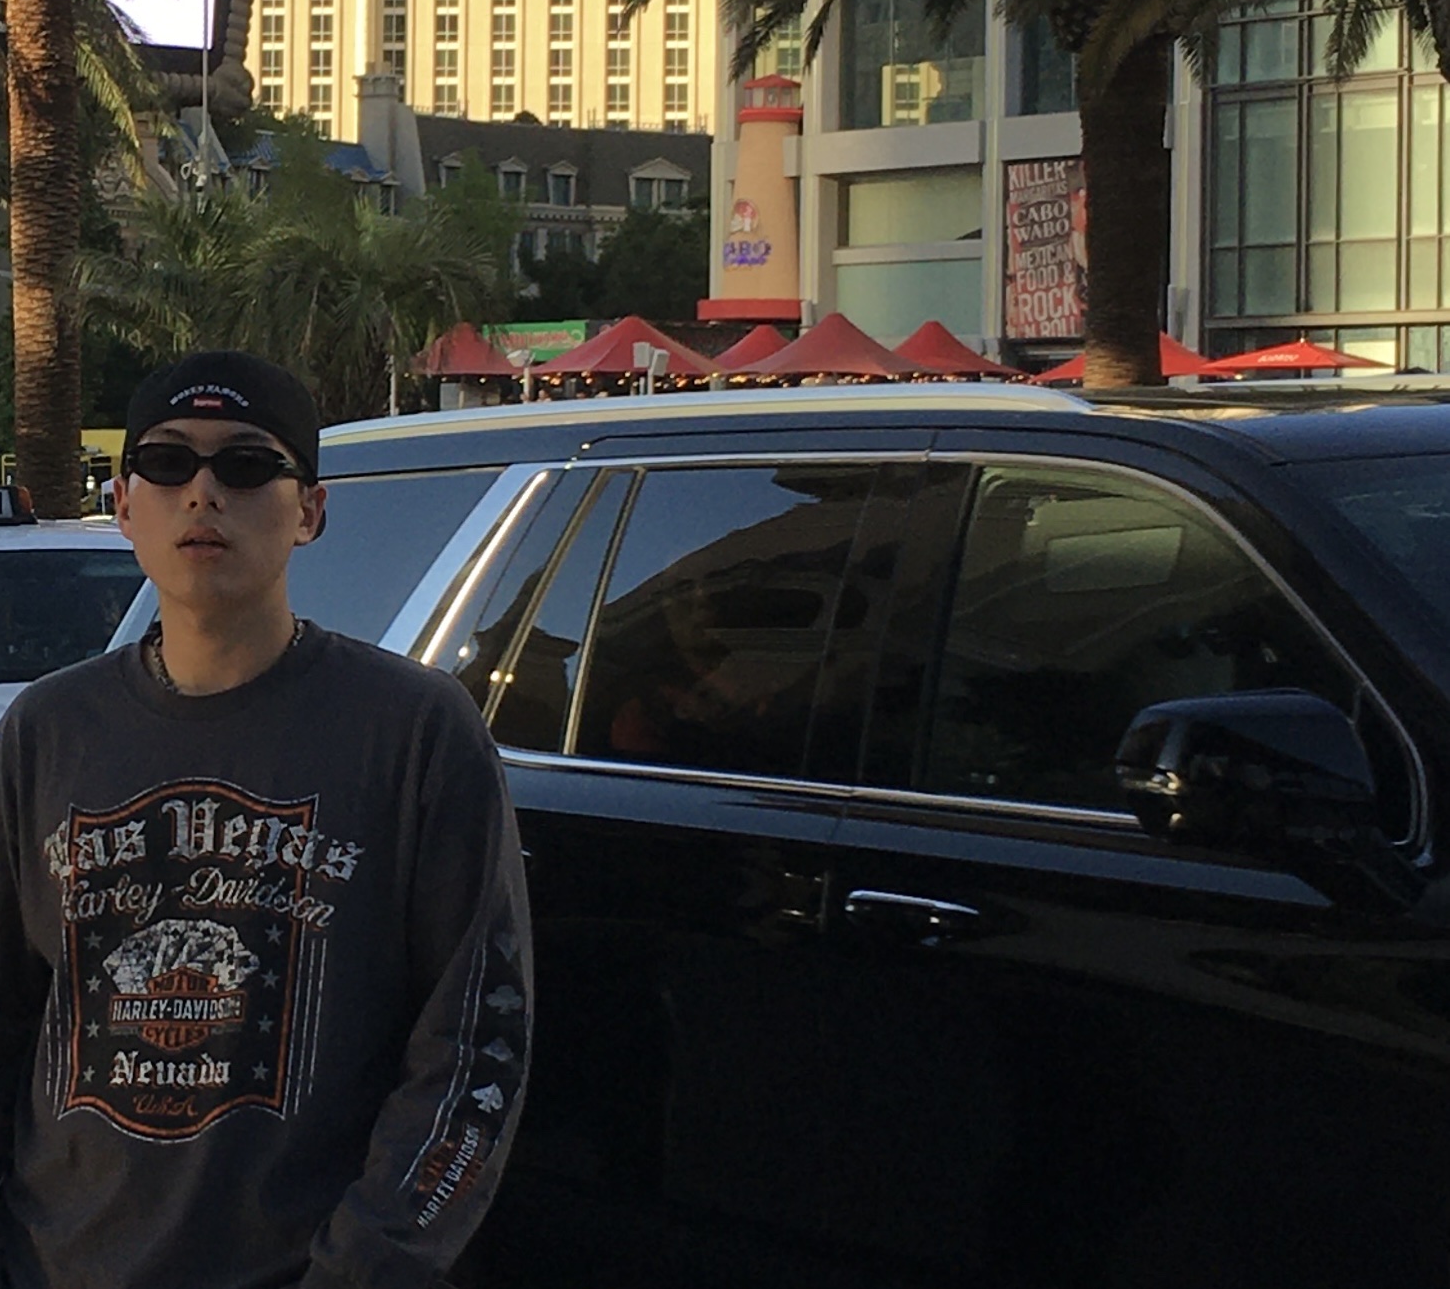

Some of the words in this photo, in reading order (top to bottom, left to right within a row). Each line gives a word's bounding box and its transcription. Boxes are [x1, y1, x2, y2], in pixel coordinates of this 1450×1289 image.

[1007, 161, 1066, 190] KILLER
[1012, 199, 1069, 226] CABO
[1014, 218, 1070, 243] WABO
[1015, 243, 1073, 269] MEXICAN
[1016, 264, 1059, 293] FOOD
[1062, 262, 1076, 284] &
[1018, 284, 1078, 324] ROCK
[161, 797, 366, 881] Vegas
[112, 997, 241, 1022] HARLEY-DAVIDSON
[109, 1051, 232, 1088] Nevada
